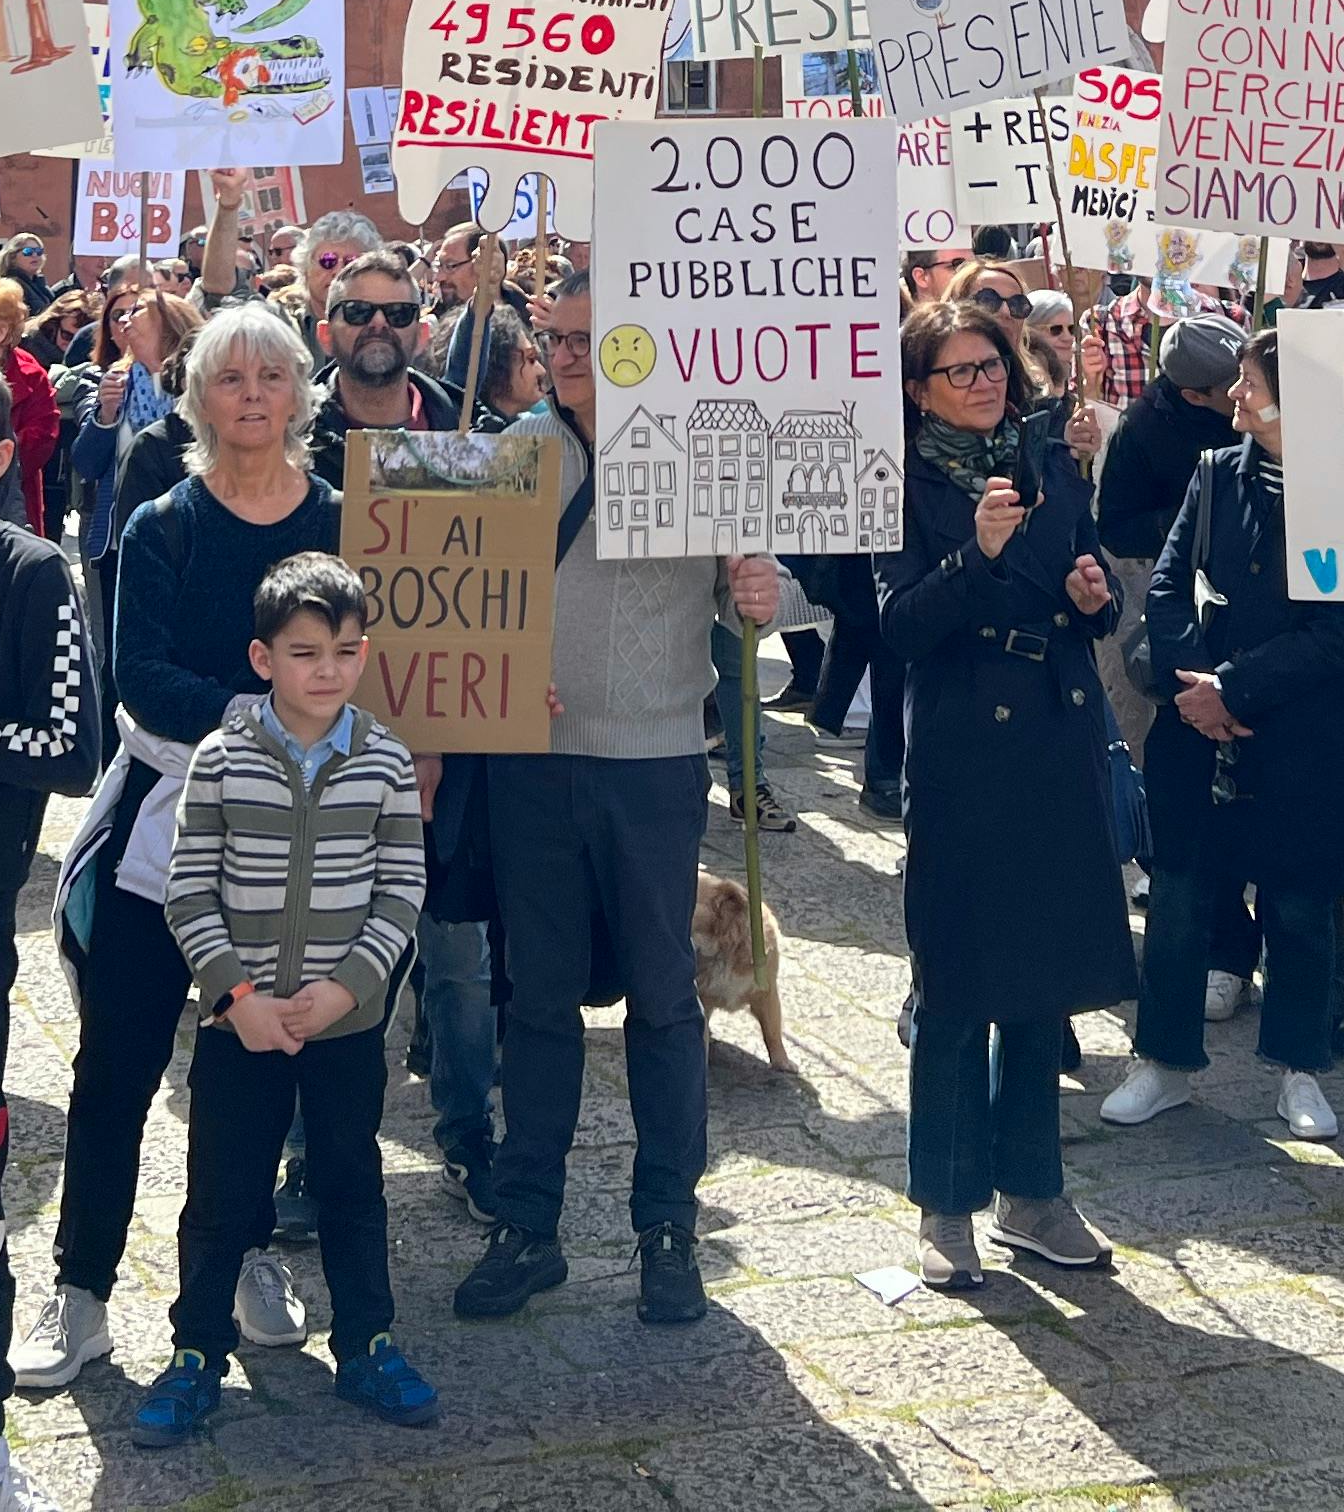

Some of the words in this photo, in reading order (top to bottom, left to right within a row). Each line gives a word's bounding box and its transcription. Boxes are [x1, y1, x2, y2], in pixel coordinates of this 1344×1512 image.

[1197, 24, 1287, 68] CON
[439, 54, 656, 100] RESIDENTI
[1079, 68, 1162, 120] SOS
[398, 89, 621, 150] RESILIENT
[650, 132, 855, 192] 2.000
[1071, 185, 1138, 222] MEDICI
[1164, 163, 1297, 225] SIAMO
[674, 202, 818, 244] CASE
[628, 257, 878, 300] PUBBLICHE
[668, 322, 882, 386] VUOTE
[442, 514, 483, 557] AI
[359, 565, 529, 631] BOSCHI
[378, 651, 511, 719] VERI
